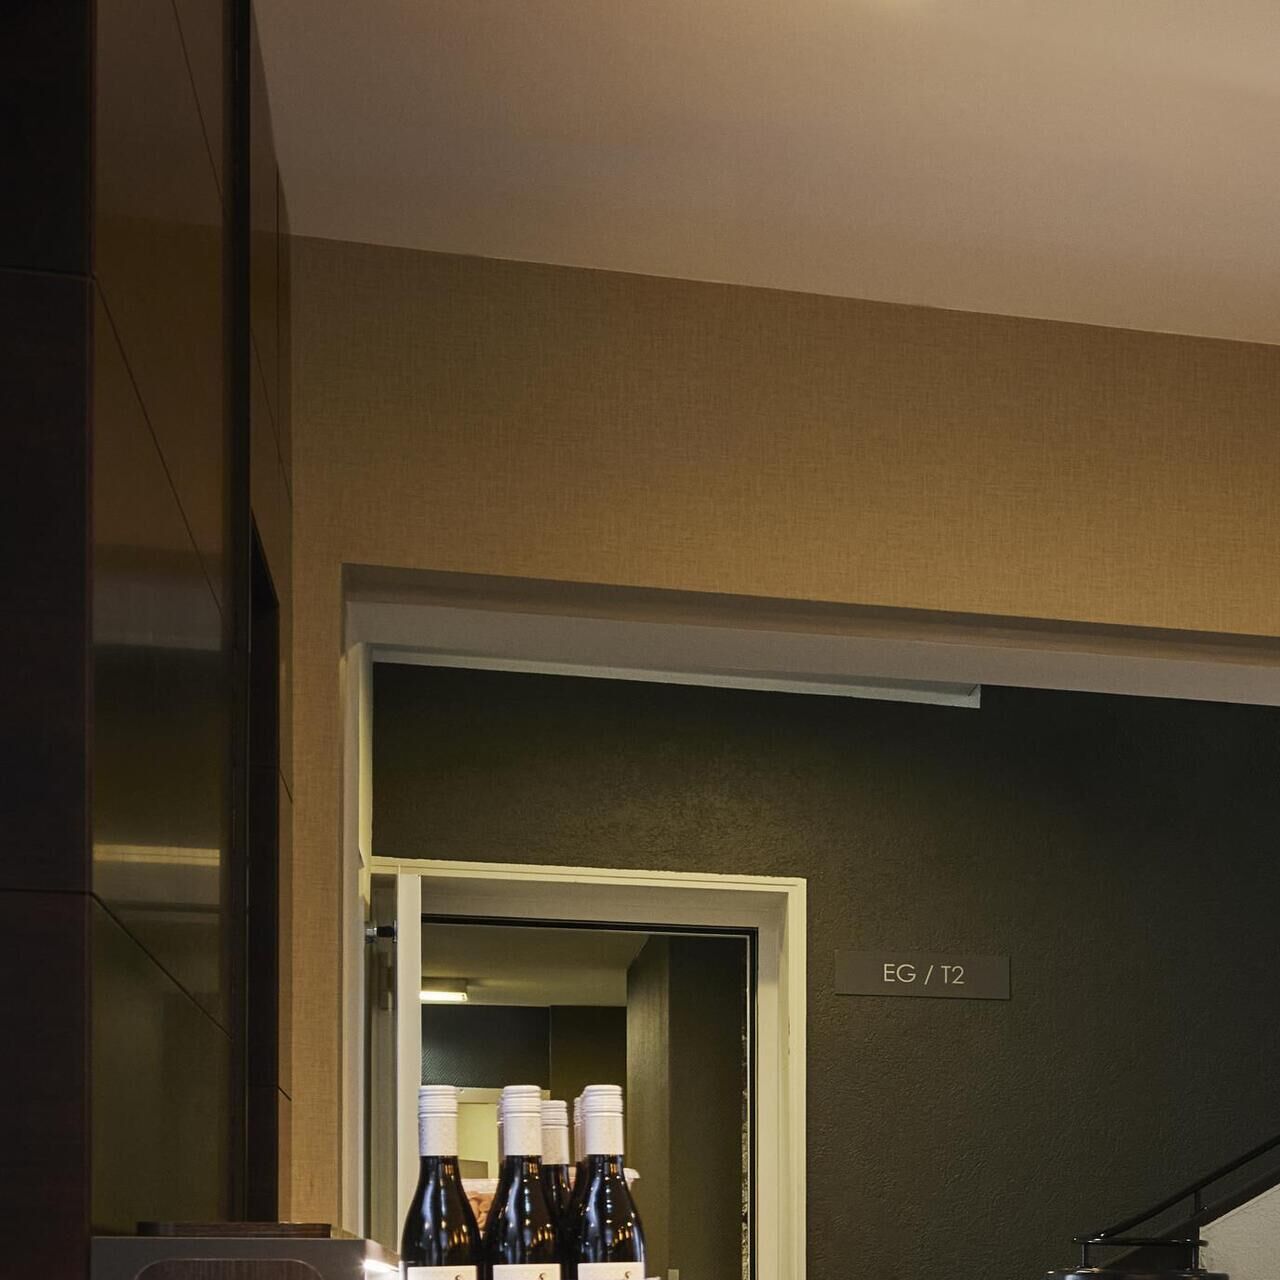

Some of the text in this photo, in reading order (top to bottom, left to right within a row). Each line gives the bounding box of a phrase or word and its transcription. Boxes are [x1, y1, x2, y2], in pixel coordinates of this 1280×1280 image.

[883, 963, 965, 986] EG / T2
